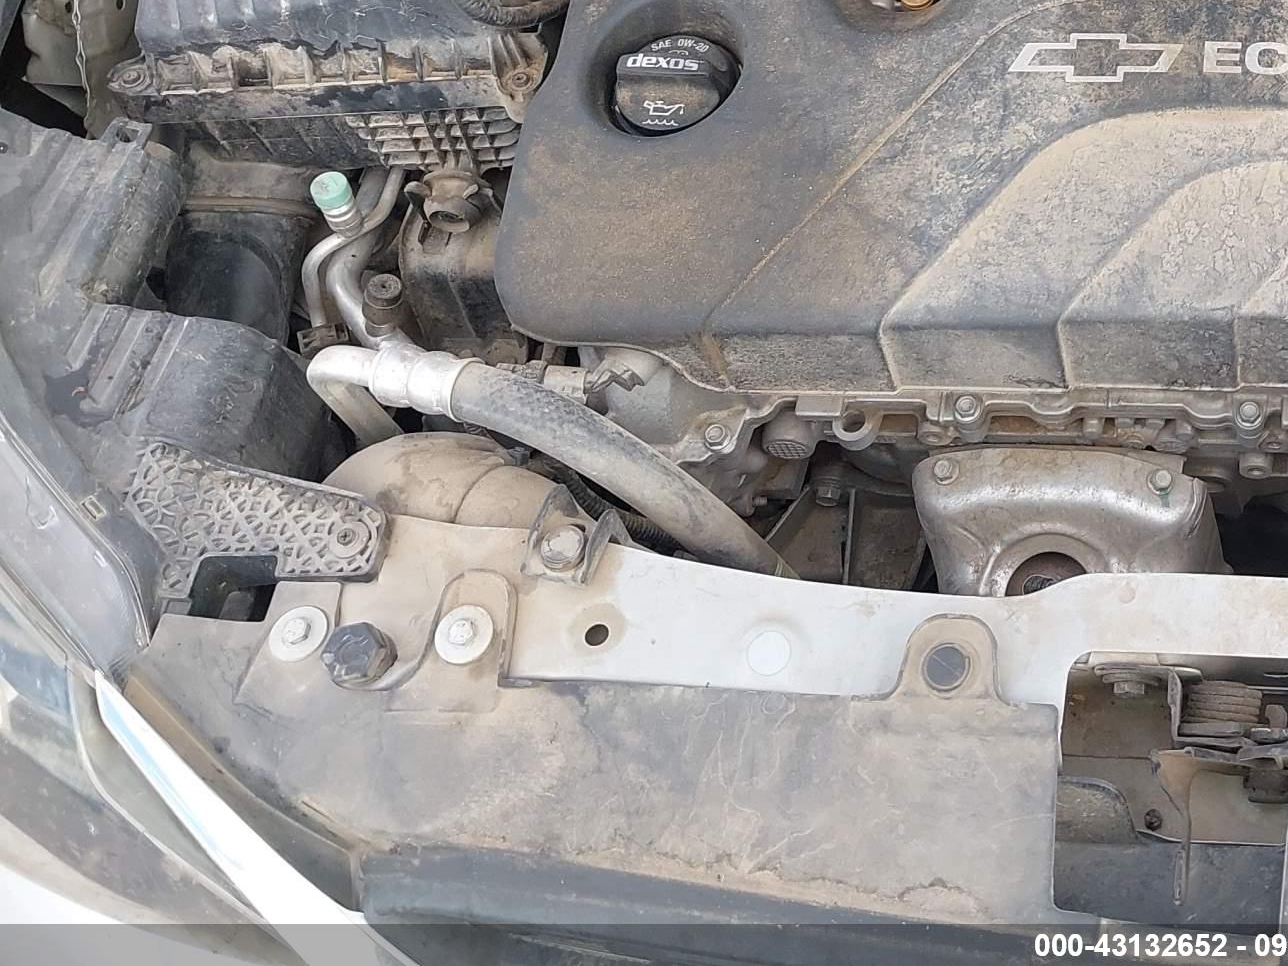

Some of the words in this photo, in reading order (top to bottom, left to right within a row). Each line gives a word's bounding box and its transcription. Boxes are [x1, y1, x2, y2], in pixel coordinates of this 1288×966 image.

[651, 39, 673, 52] SAE
[677, 38, 710, 53] 0W-20
[626, 53, 699, 72] dexos
